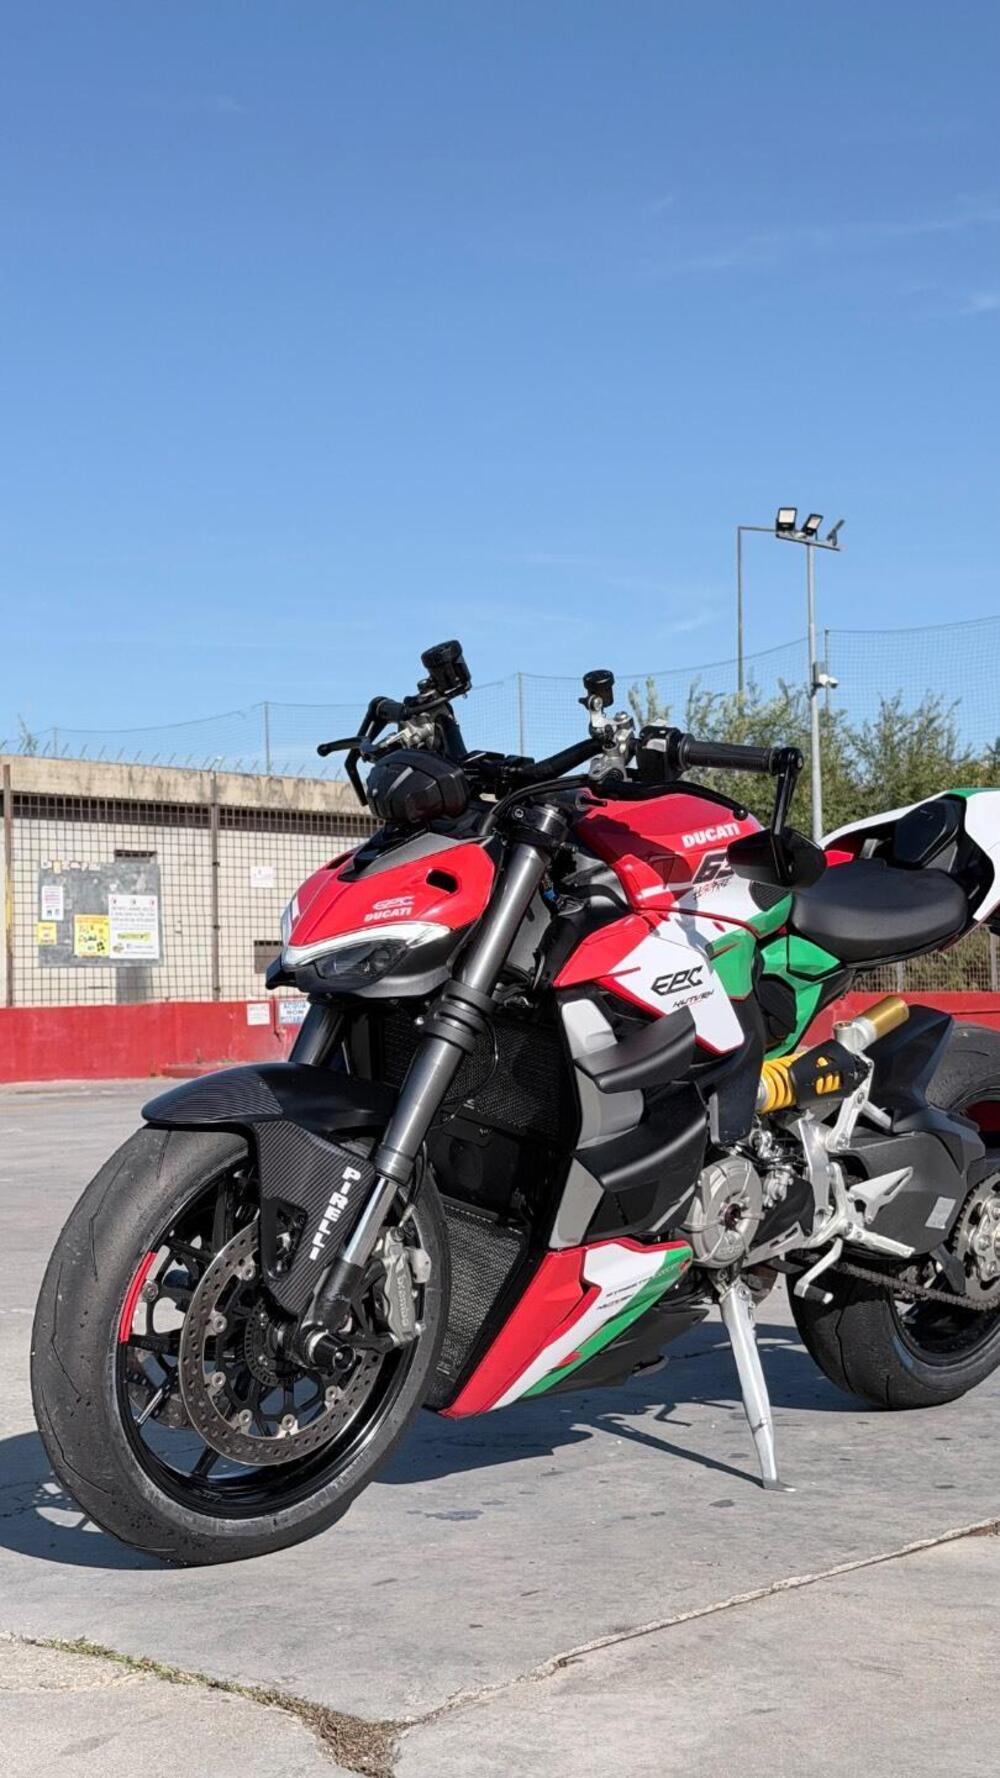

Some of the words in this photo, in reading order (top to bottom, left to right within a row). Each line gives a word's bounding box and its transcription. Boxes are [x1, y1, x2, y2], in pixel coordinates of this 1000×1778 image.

[682, 823, 740, 848] DUCATI
[364, 907, 413, 922] DUCATI
[651, 965, 703, 996] EPC
[309, 1166, 361, 1261] PIRELLI
